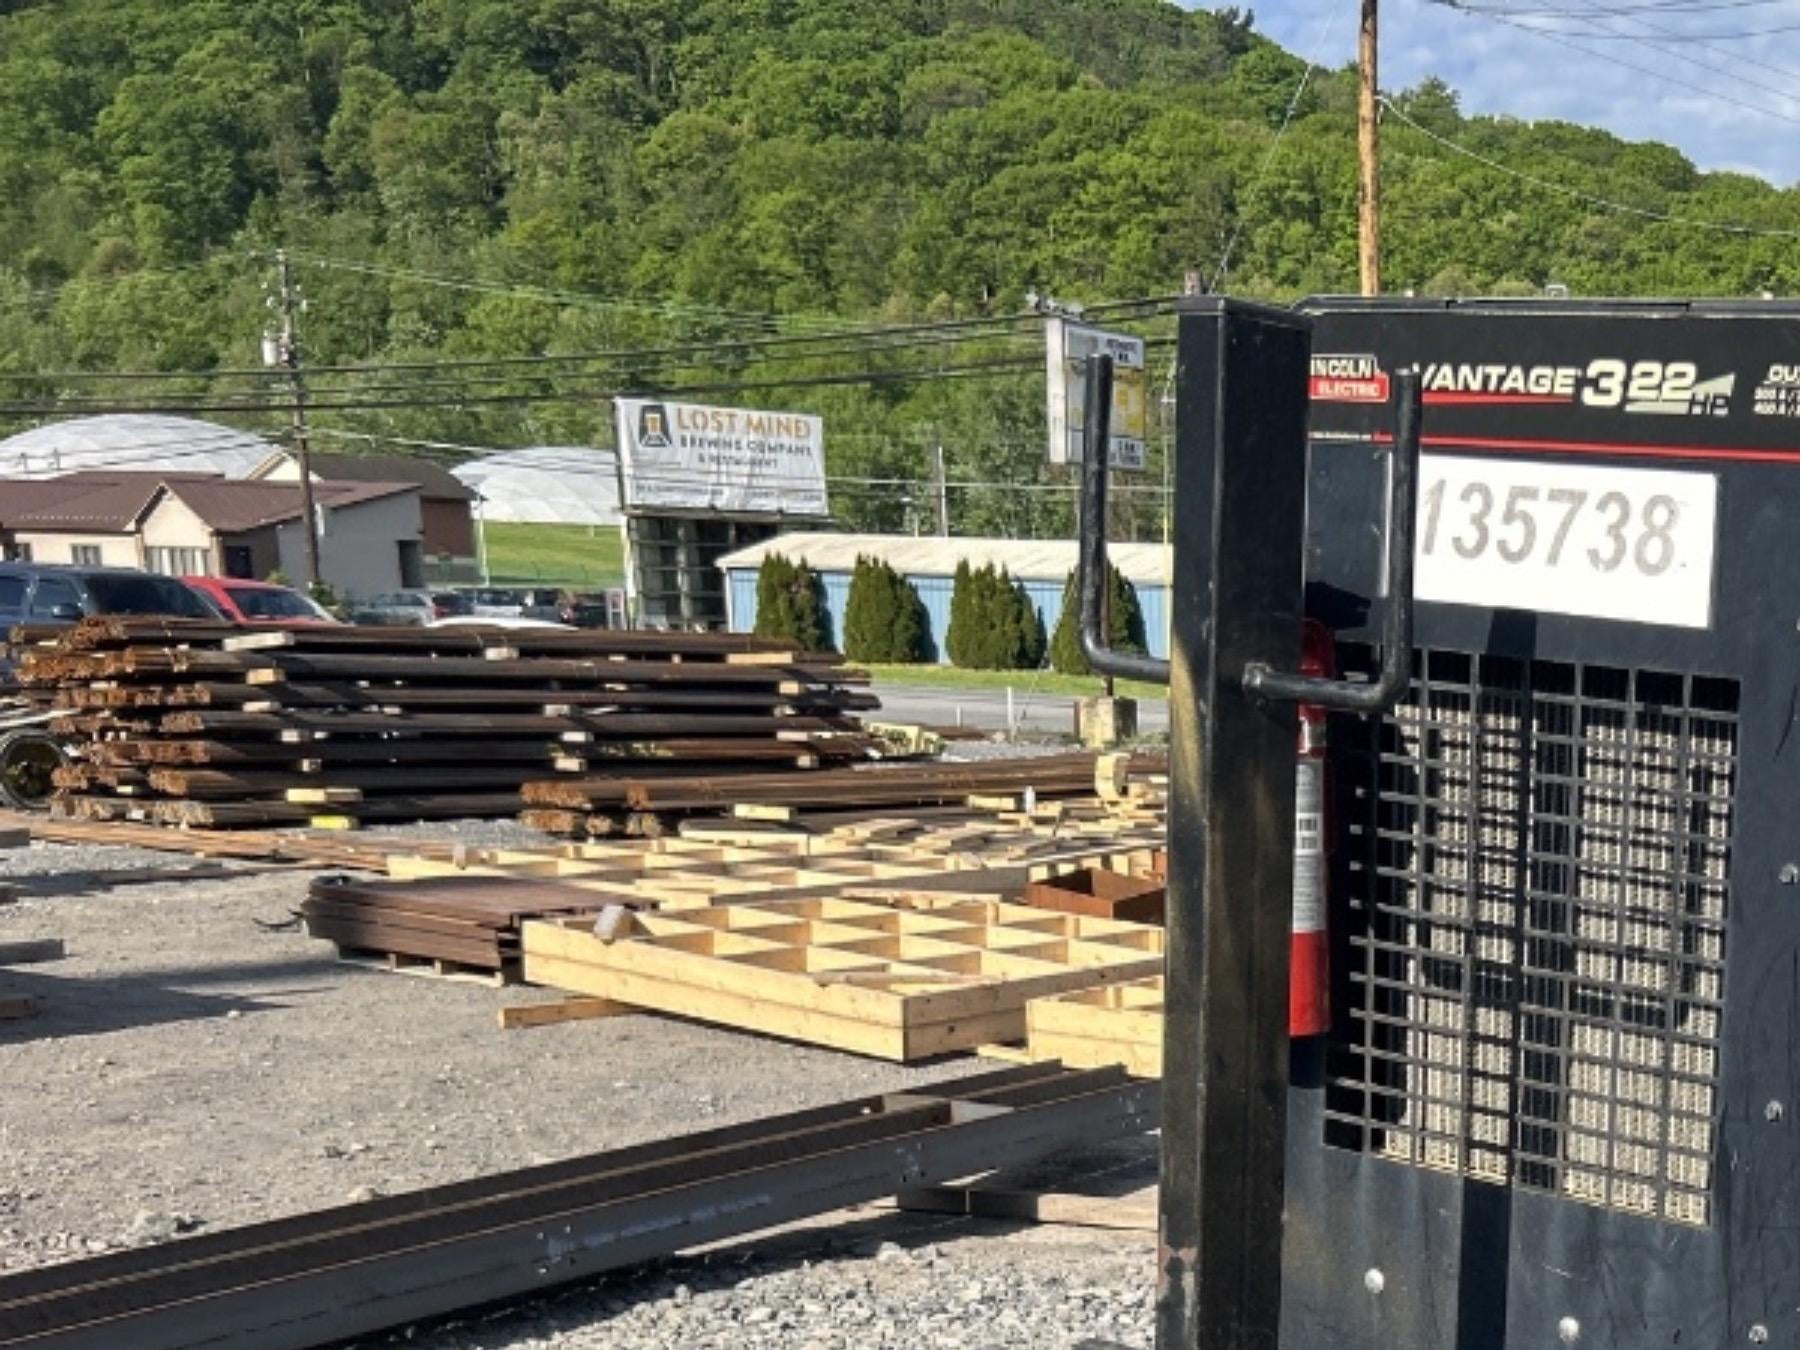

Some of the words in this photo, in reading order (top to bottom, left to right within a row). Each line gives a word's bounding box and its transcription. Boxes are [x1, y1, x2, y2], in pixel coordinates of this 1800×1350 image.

[1310, 358, 1373, 378] INCOLN
[1582, 358, 1697, 406] 322
[677, 407, 738, 433] LOST
[746, 413, 811, 438] MIND
[1421, 478, 1680, 577] 135738
